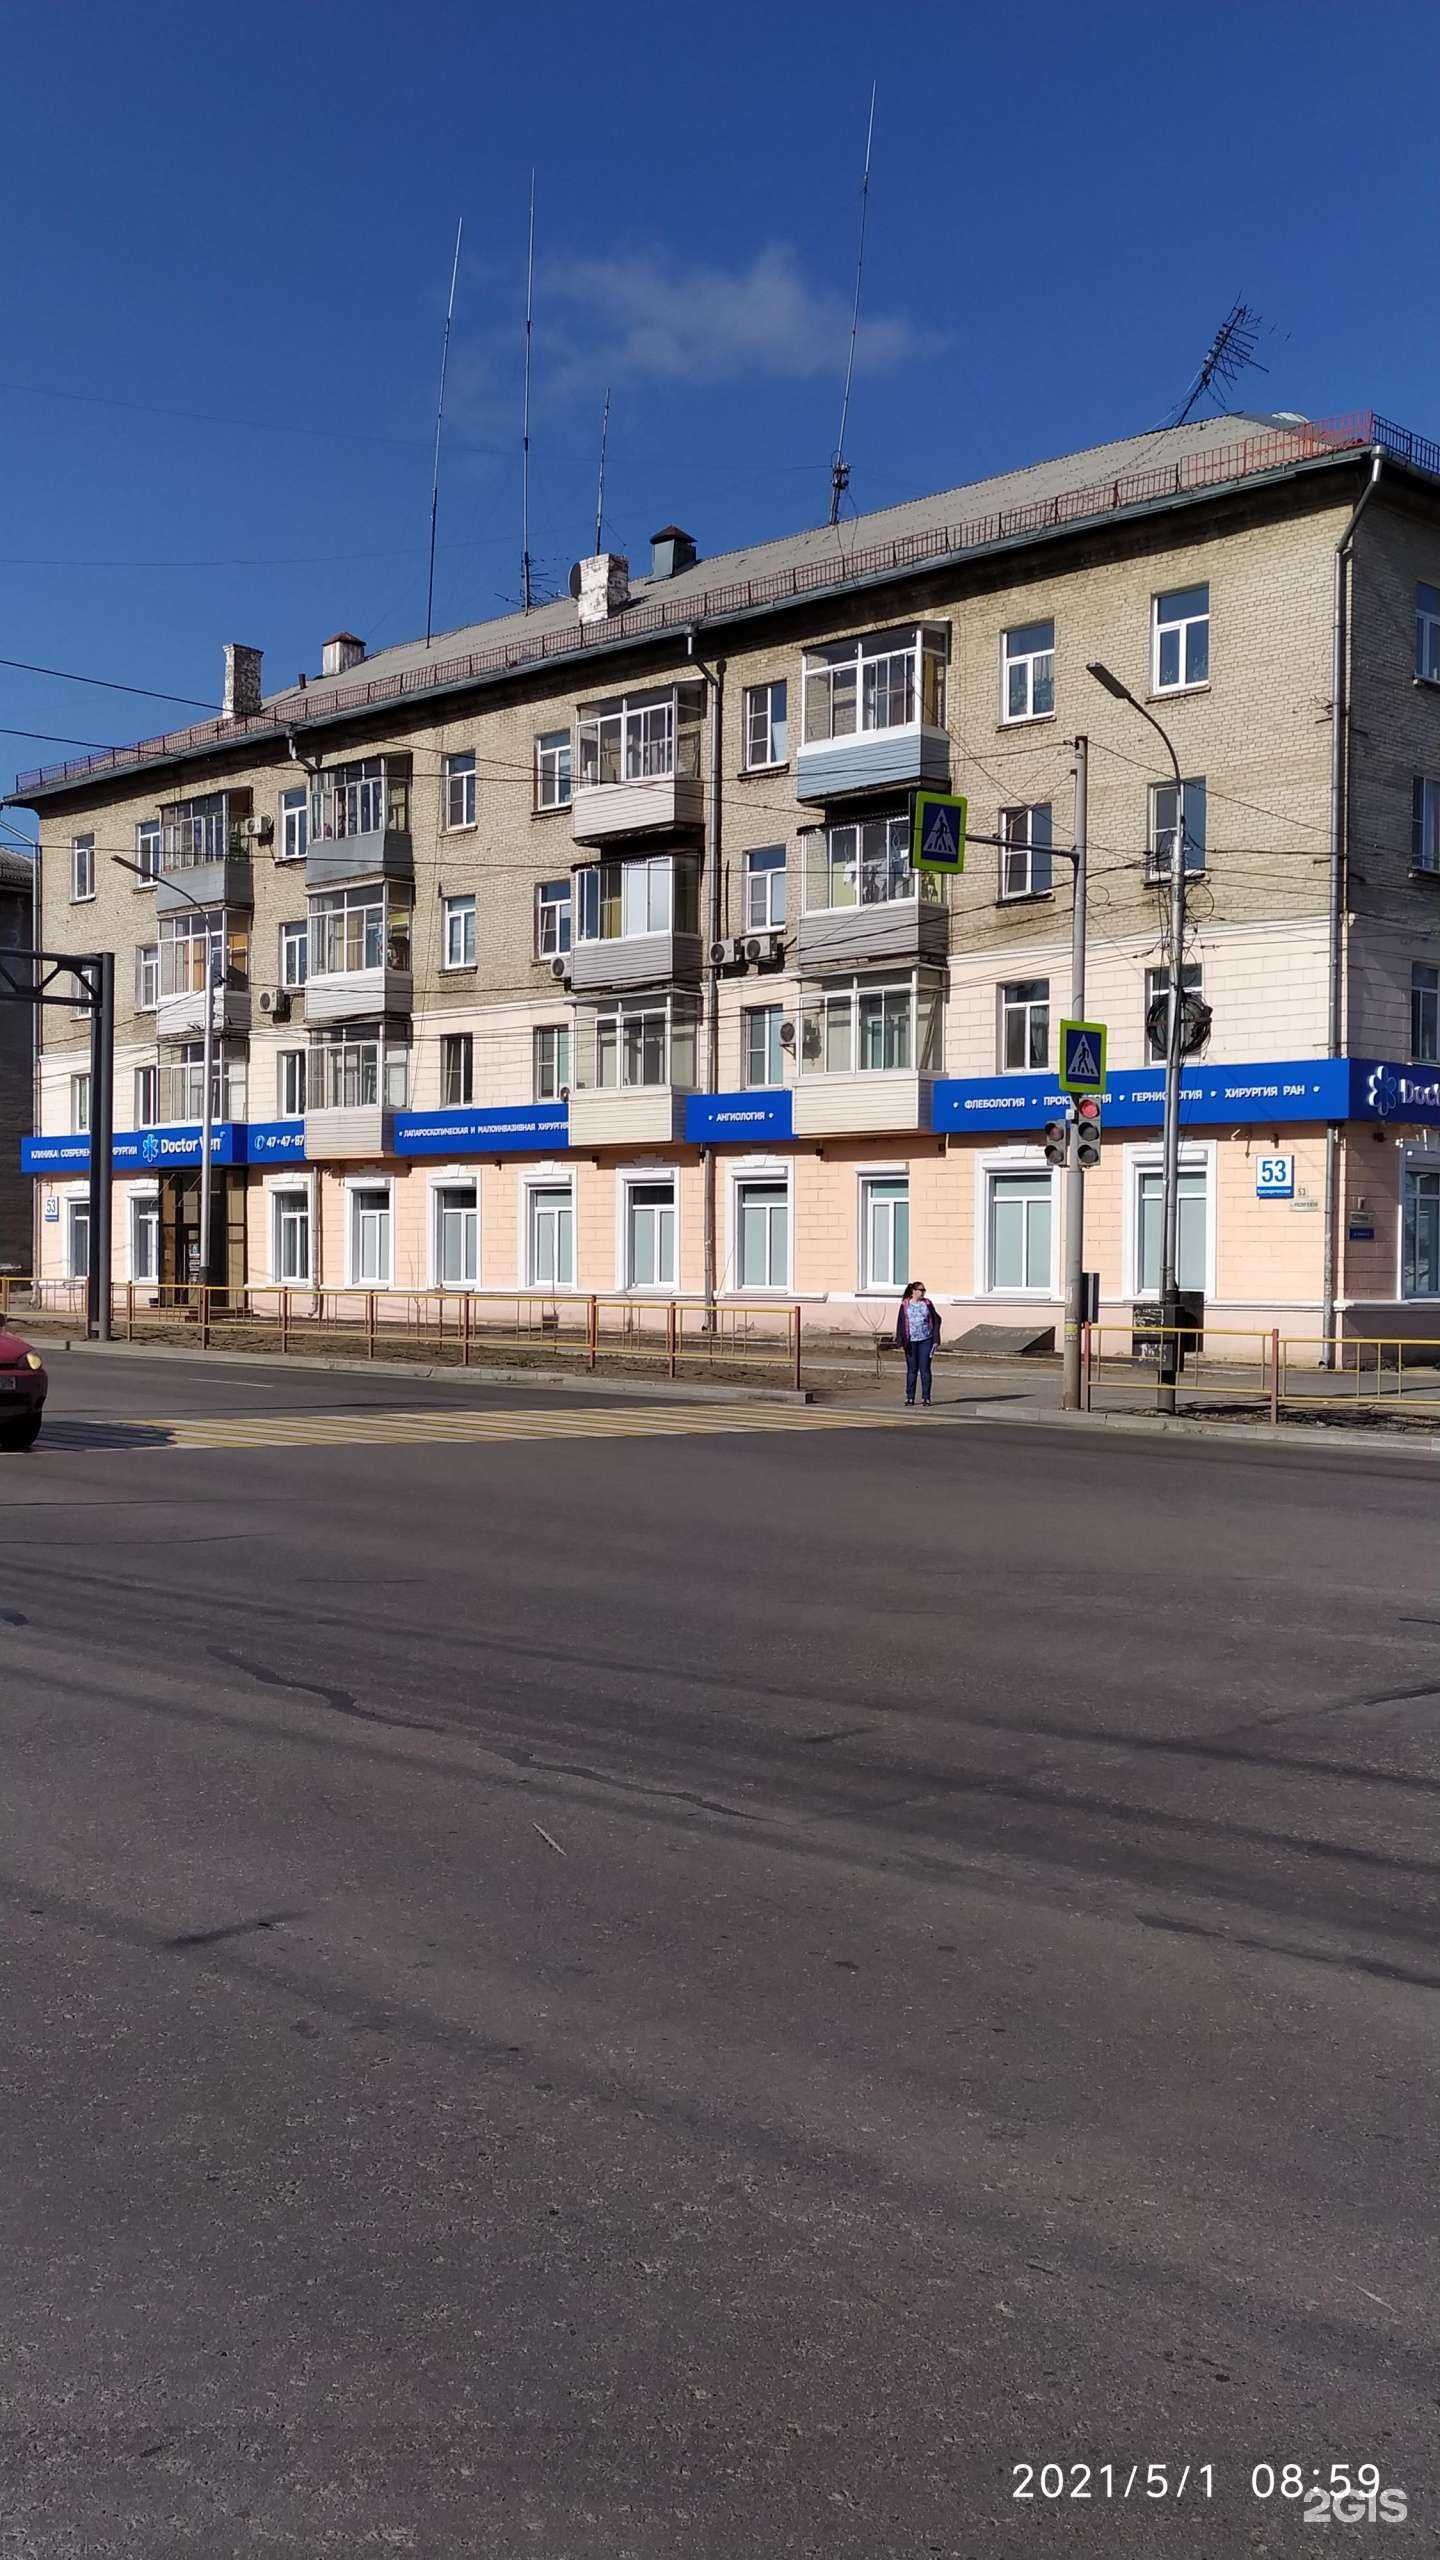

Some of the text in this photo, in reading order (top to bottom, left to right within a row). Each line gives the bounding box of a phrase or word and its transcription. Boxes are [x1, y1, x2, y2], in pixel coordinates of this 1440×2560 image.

[1131, 1089, 1203, 1102] ГЕРНИООГИЯ
[1224, 1085, 1305, 1098] ХИРУРГИЯ РАН
[964, 1097, 1025, 1110] ФЛЕБОЛОГИЯ
[716, 1111, 765, 1122] АНГИОЛОГИЯ
[403, 1126, 469, 1138] ЛАПАРОСКОПИЧЕСКАЯ
[478, 1123, 535, 1134] МАЛОИНВАЗИВНАЯ
[161, 1136, 198, 1154] Doctor
[1261, 1159, 1287, 1183] 53
[46, 1199, 56, 1213] 53
